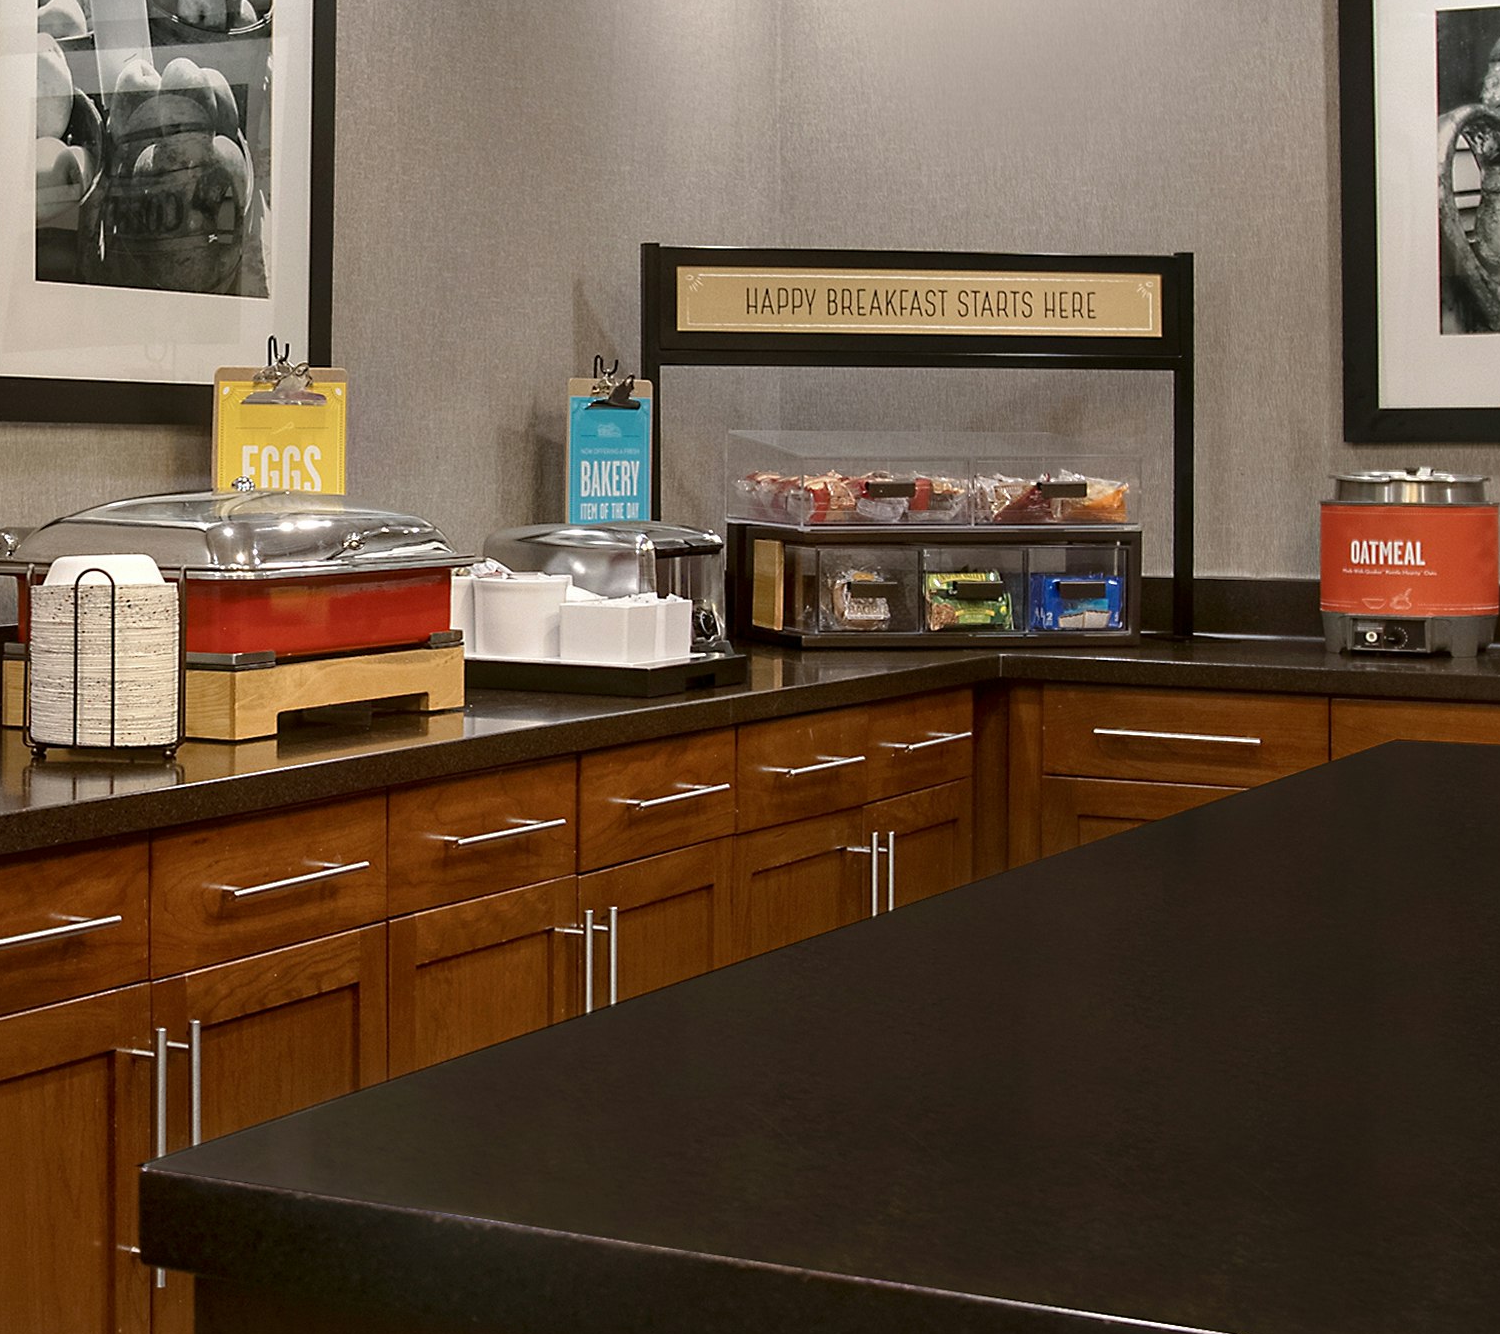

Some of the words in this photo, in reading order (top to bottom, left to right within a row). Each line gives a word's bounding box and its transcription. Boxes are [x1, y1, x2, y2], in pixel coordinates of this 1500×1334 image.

[746, 287, 816, 316] HAPPY
[827, 288, 948, 317] BREAKFAST
[958, 290, 1034, 319] STARTS
[1044, 291, 1097, 319] HERE
[242, 445, 322, 492] EGGS
[581, 460, 640, 497] BAKERY
[580, 503, 598, 520] ITEM
[600, 503, 609, 520] OF
[611, 502, 624, 519] THE
[627, 502, 640, 519] DAY
[1350, 540, 1426, 566] OATMEAL
